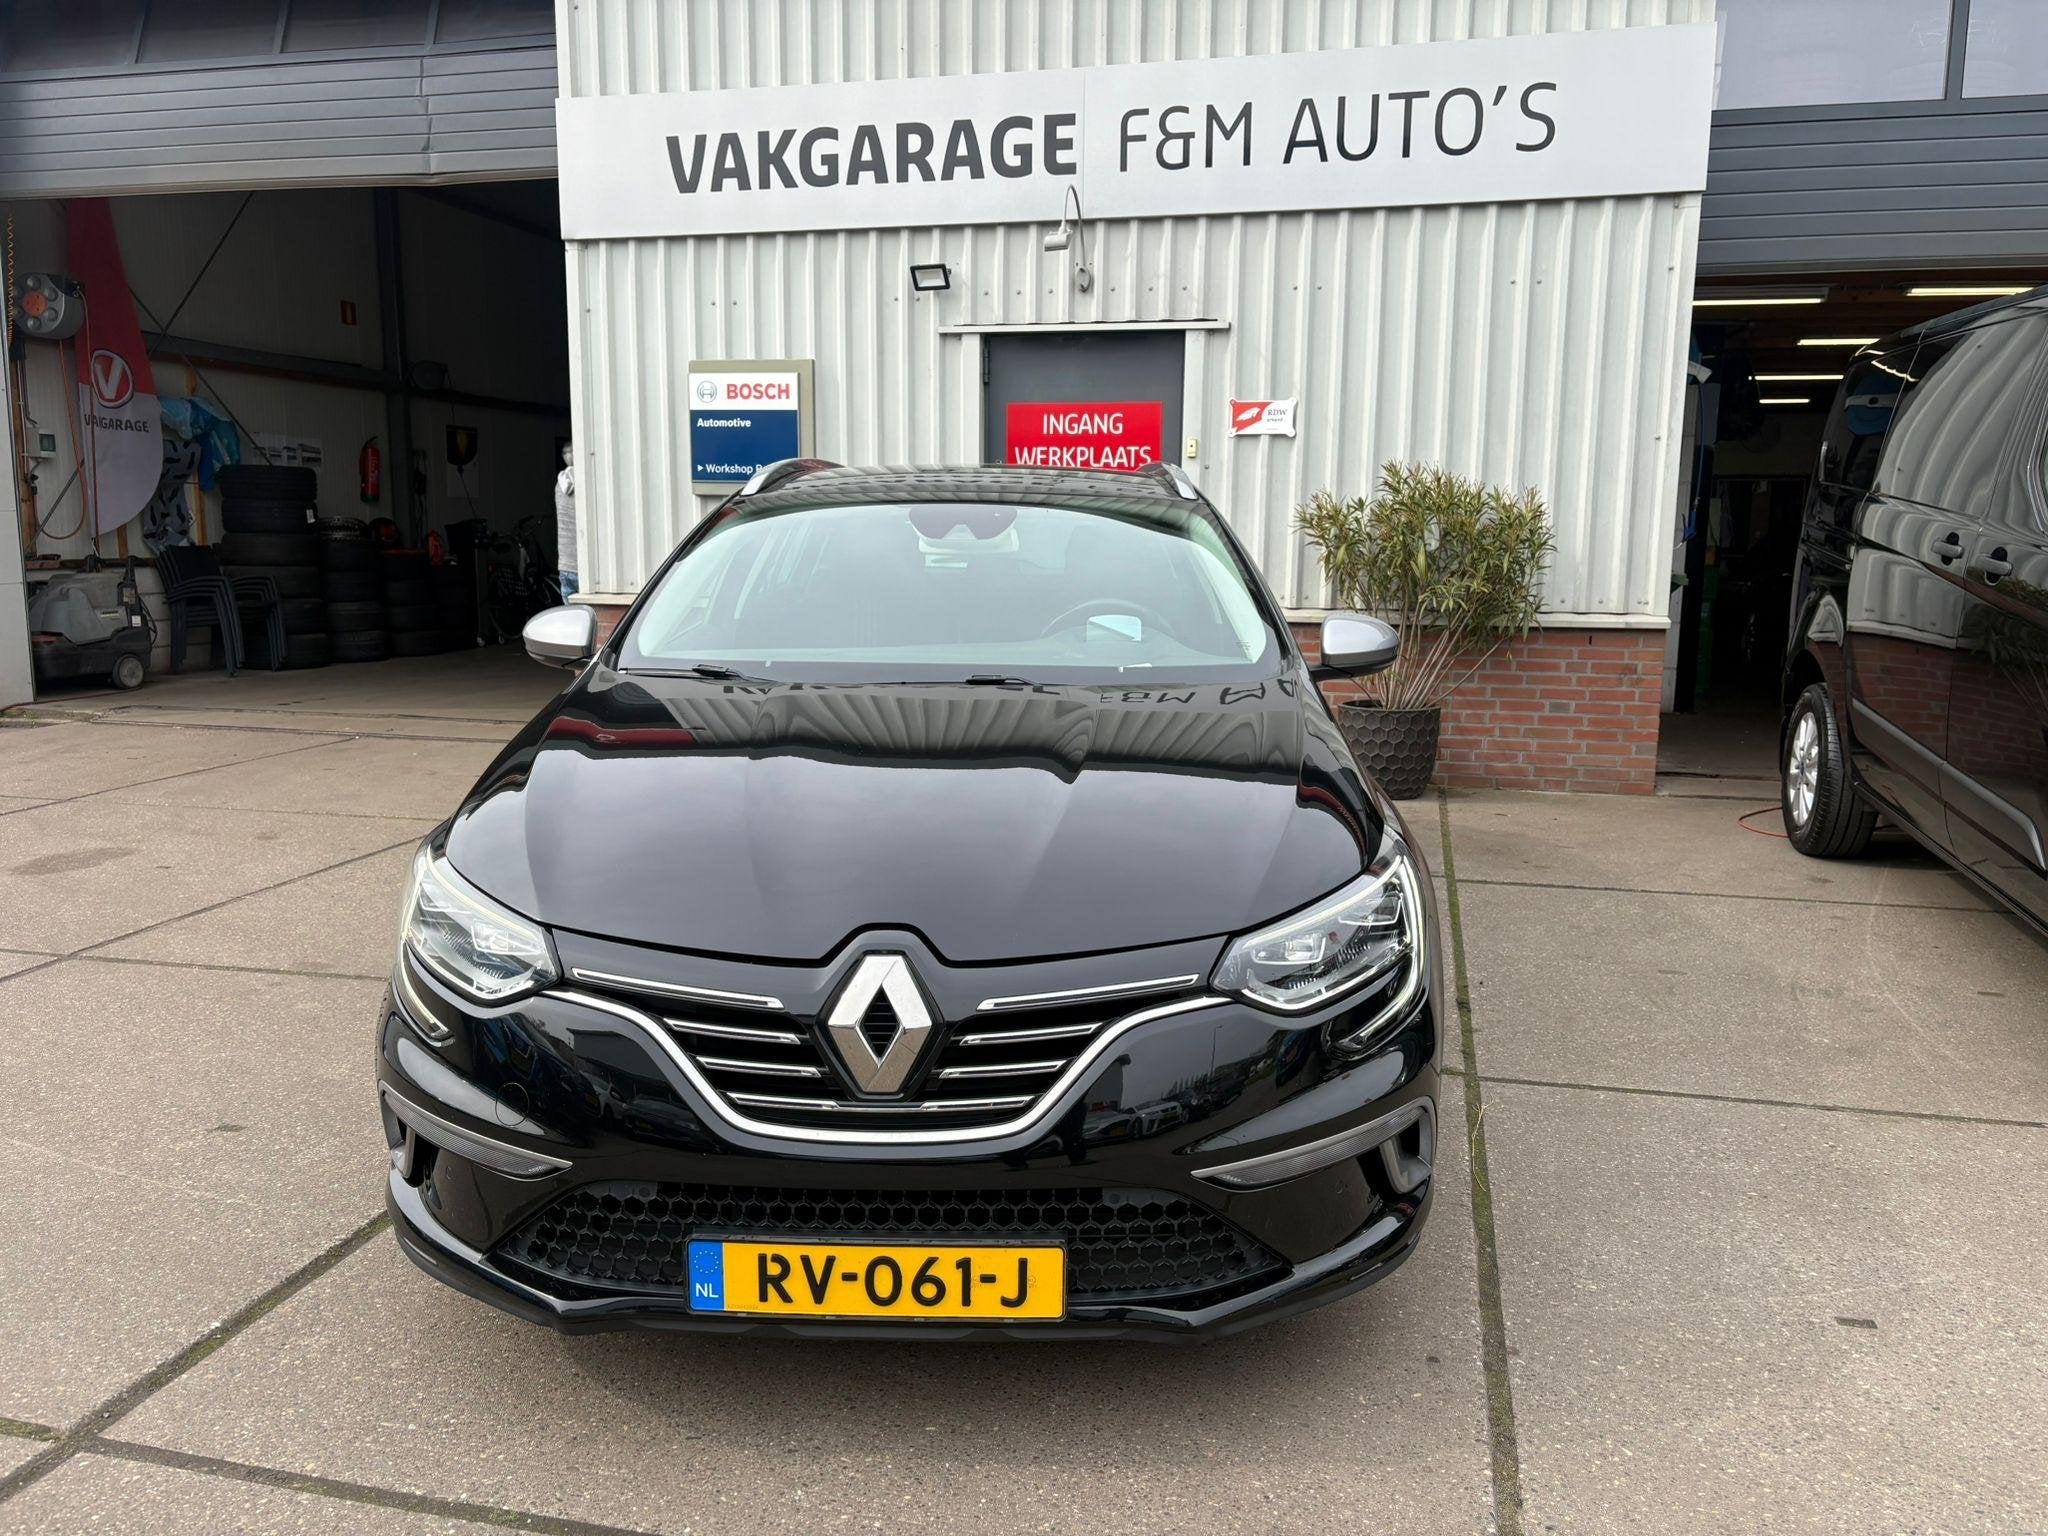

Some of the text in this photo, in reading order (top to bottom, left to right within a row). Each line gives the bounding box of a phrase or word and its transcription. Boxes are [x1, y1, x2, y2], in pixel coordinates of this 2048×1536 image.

[666, 81, 1557, 194] VAKGARAGE F&M AUTO'S
[726, 383, 790, 400] BOSCH
[697, 418, 752, 428] Automotive
[1042, 413, 1123, 435] INGANG
[1014, 446, 1152, 468] WERKPLAATS
[706, 463, 753, 475] Workshop
[695, 1282, 719, 1298] NL
[757, 1253, 1028, 1308] RV-061-J
